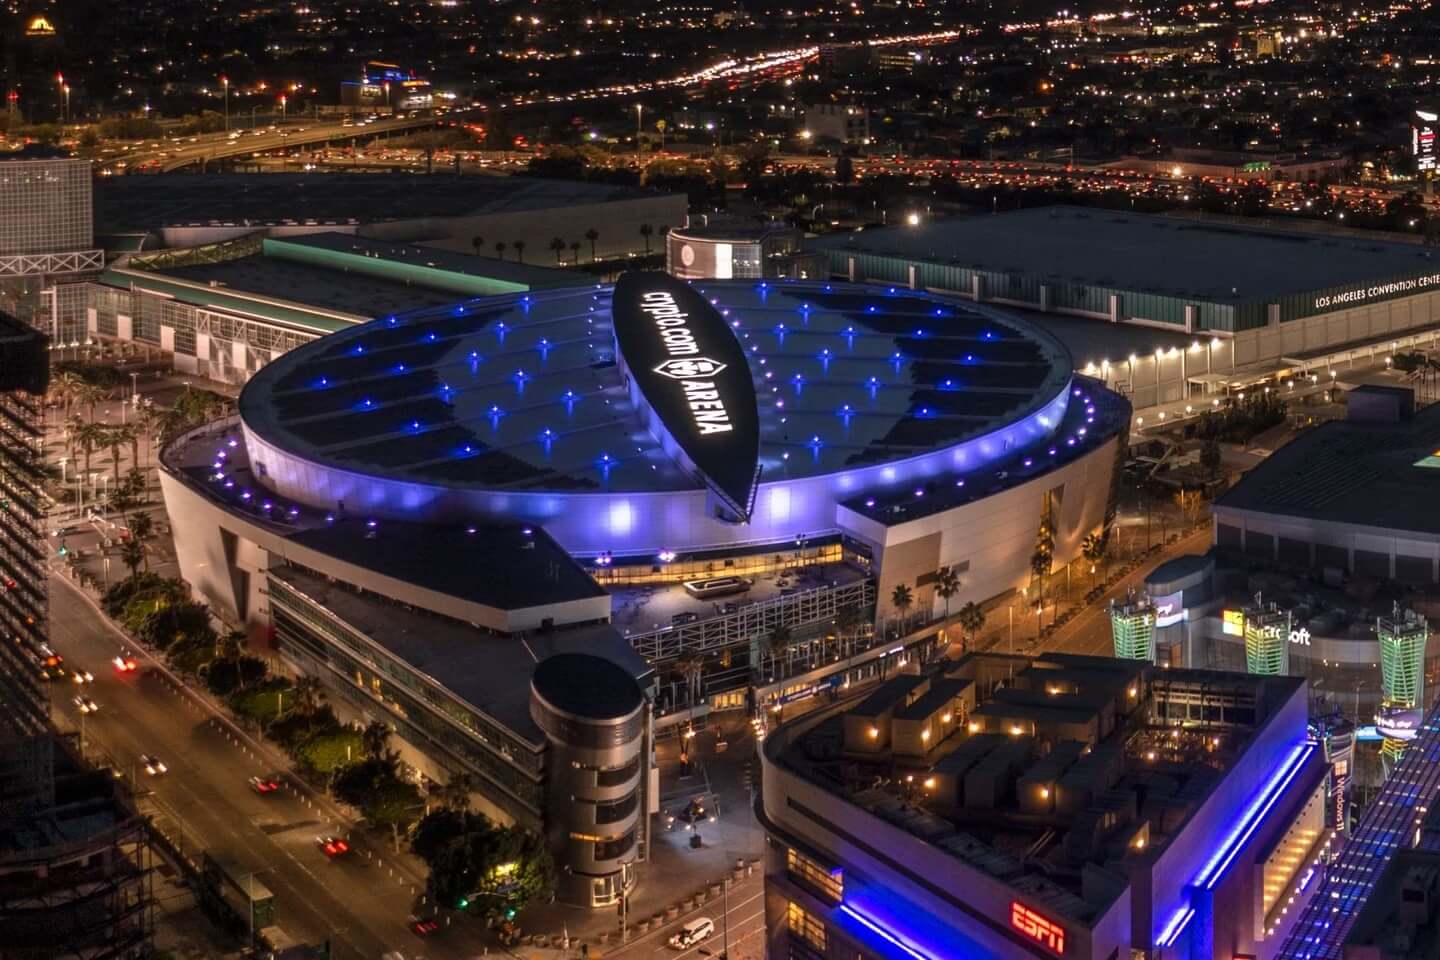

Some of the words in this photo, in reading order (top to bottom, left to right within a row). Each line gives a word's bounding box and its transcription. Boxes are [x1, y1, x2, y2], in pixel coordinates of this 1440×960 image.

[1315, 297, 1330, 308] LOS
[1332, 289, 1366, 304] ANGELES
[1367, 279, 1417, 297] CONVENTION
[640, 291, 700, 356] crypto.com
[681, 380, 734, 435] ARENA
[1012, 901, 1064, 954] ESPN
